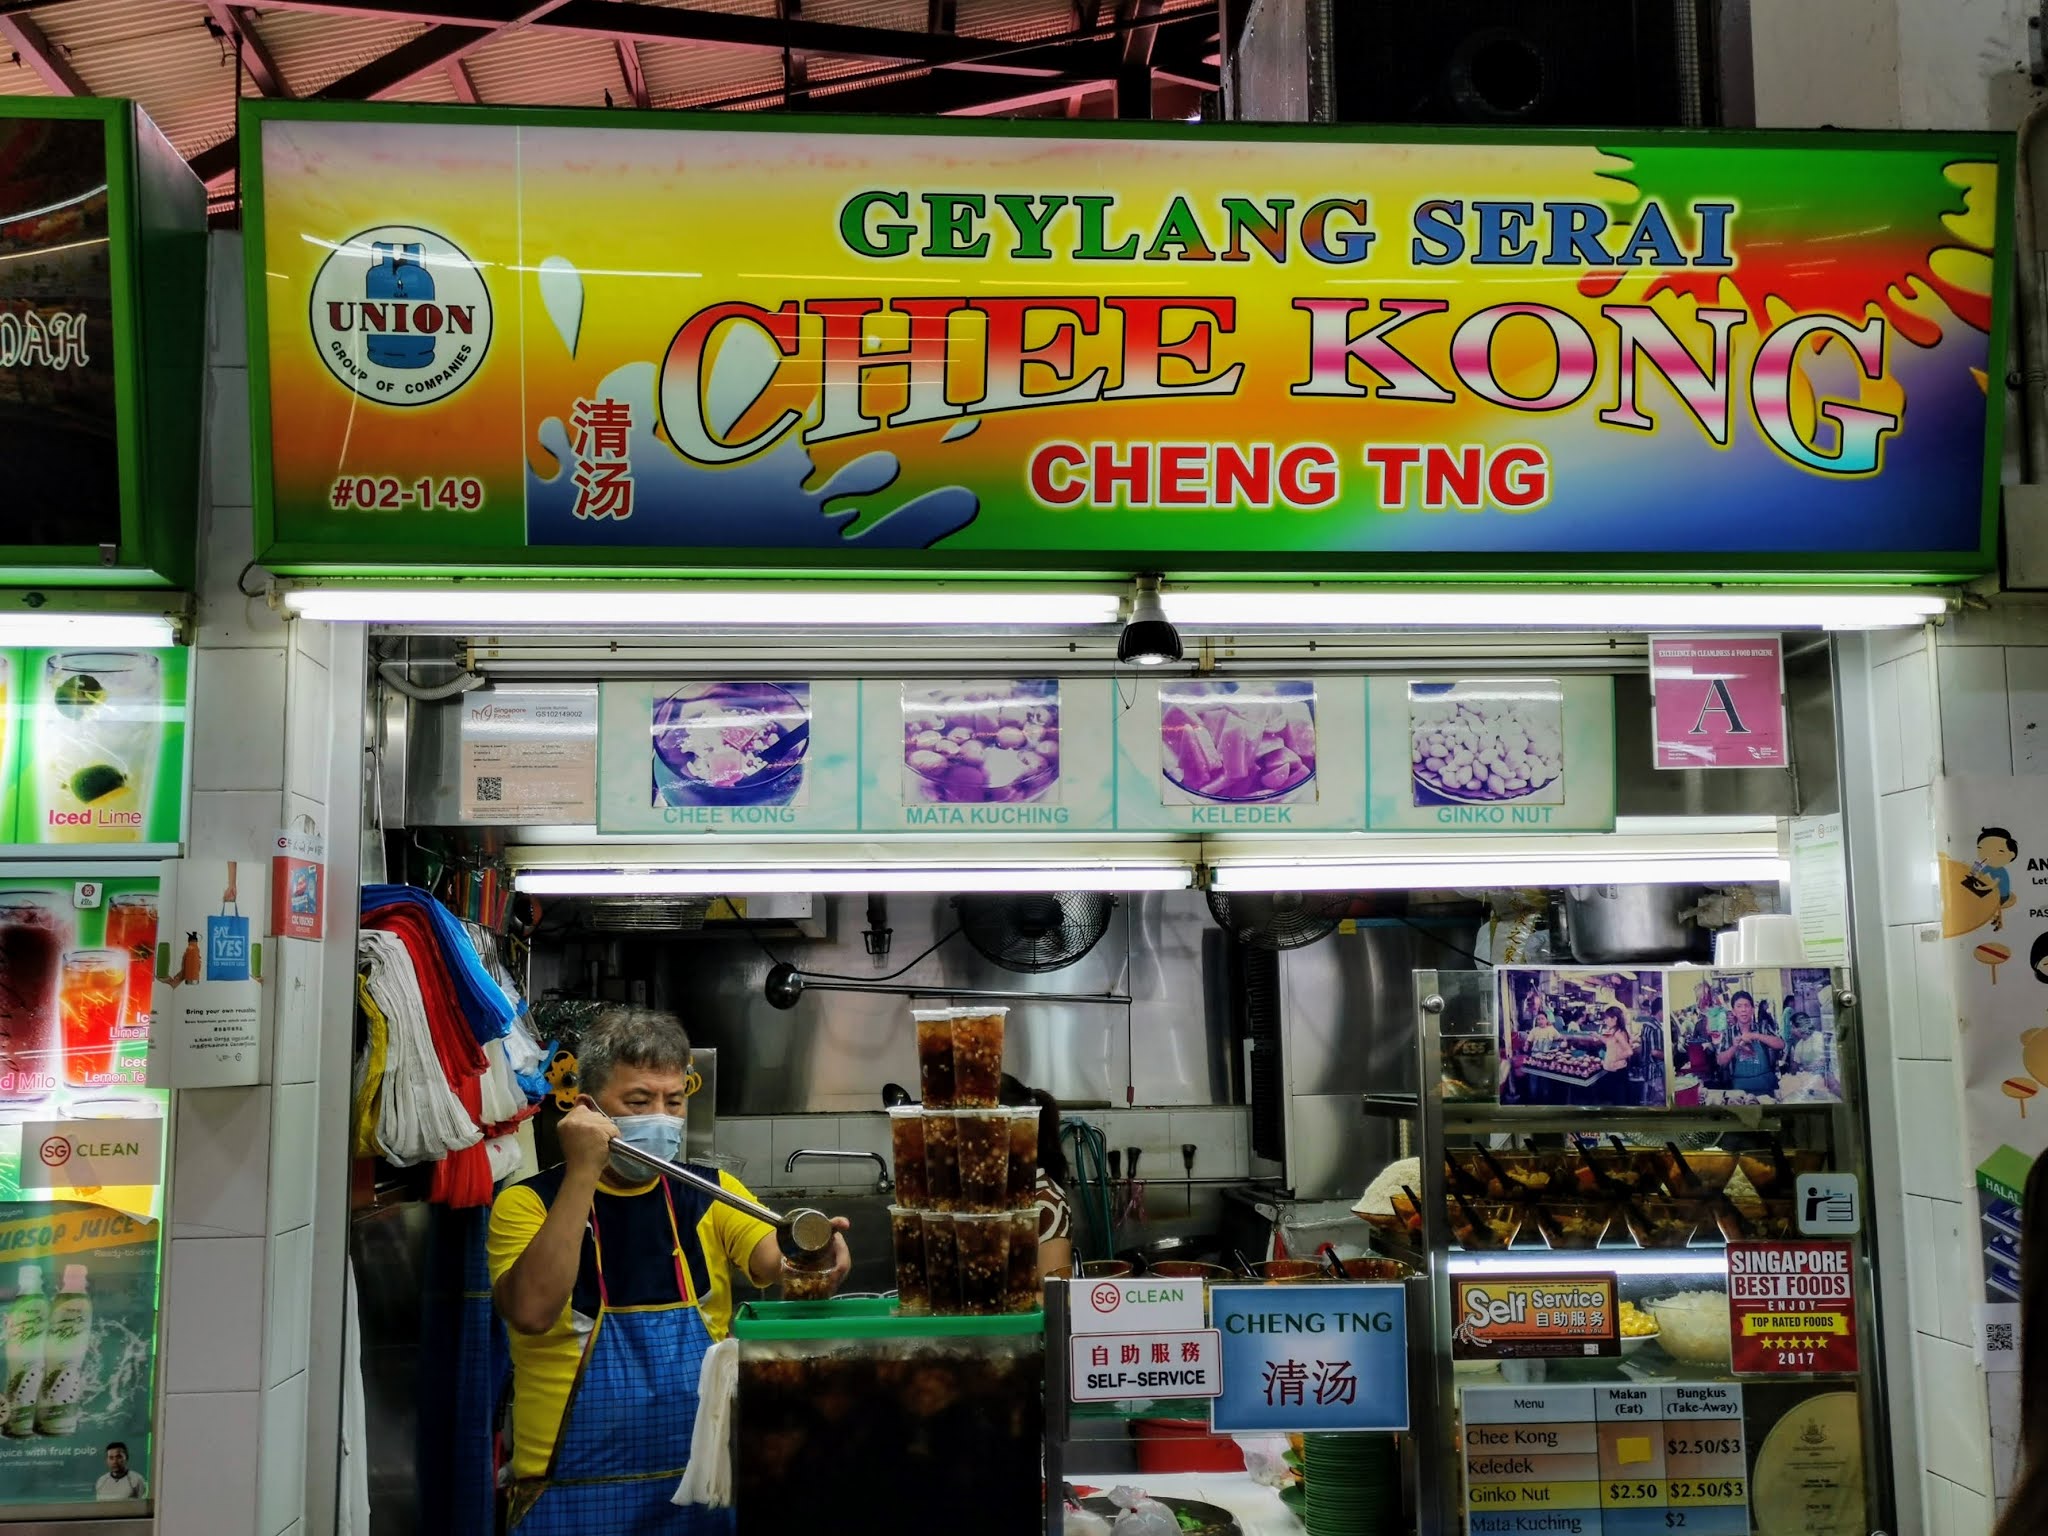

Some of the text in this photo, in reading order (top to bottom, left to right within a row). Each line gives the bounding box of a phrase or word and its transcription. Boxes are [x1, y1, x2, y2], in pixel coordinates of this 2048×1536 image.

[840, 191, 1735, 267] GEYLANG SERAI
[327, 301, 476, 335] UNION
[331, 341, 472, 394] GROUP OF COMPANIES
[658, 296, 1898, 475] CHEE KONG
[571, 399, 633, 520] 清汤
[1030, 444, 1548, 508] CHENG TNG
[332, 478, 482, 510] #02-149
[1688, 679, 1752, 735] A
[50, 809, 142, 825] Iced Lime
[663, 807, 796, 824] CHEE KONG
[906, 806, 1069, 825] MATA KUCHING
[1191, 806, 1292, 824] KELEDEK
[1437, 806, 1553, 824] GINKO NUT
[214, 926, 230, 936] SAY
[216, 940, 243, 957] YES
[109, 1026, 139, 1038] Lime
[18, 1072, 57, 1090] Milo
[84, 1071, 131, 1083] Lemon
[76, 1142, 139, 1158] CLEAN
[73, 1215, 134, 1242] JUICE
[1730, 1250, 1848, 1275] SINGAPORE
[1735, 1276, 1846, 1297] BEST FOODS
[1094, 1289, 1184, 1305] SG CLEAN
[1768, 1300, 1817, 1312] ENJOY
[1466, 1288, 1604, 1328] Self Service
[1225, 1311, 1393, 1334] CHENG TNG
[1536, 1311, 1605, 1328] 自助服务
[1751, 1316, 1834, 1329] TOP RATED FOODS
[1092, 1341, 1201, 1367] 自助服務
[1778, 1351, 1815, 1366] 2017
[1087, 1369, 1206, 1389] SELF-SERVICE
[1262, 1359, 1358, 1407] 清汤
[1609, 1388, 1647, 1400] Makan
[1676, 1387, 1727, 1402] Bungkus
[1513, 1399, 1545, 1409] Menu
[1615, 1402, 1644, 1416] (Eat)
[1666, 1401, 1739, 1416] (Take-Away)
[1467, 1430, 1559, 1447] Chee Kong
[1668, 1438, 1741, 1456] $2.50/$3
[50, 1446, 72, 1456] fruit
[74, 1446, 97, 1456] pulp
[1468, 1458, 1534, 1475] Keledek
[1469, 1486, 1551, 1503] Ginko Nut
[1610, 1484, 1657, 1501] $2.50
[1670, 1481, 1743, 1499] $2.50/$3
[1665, 1511, 1686, 1529] $2
